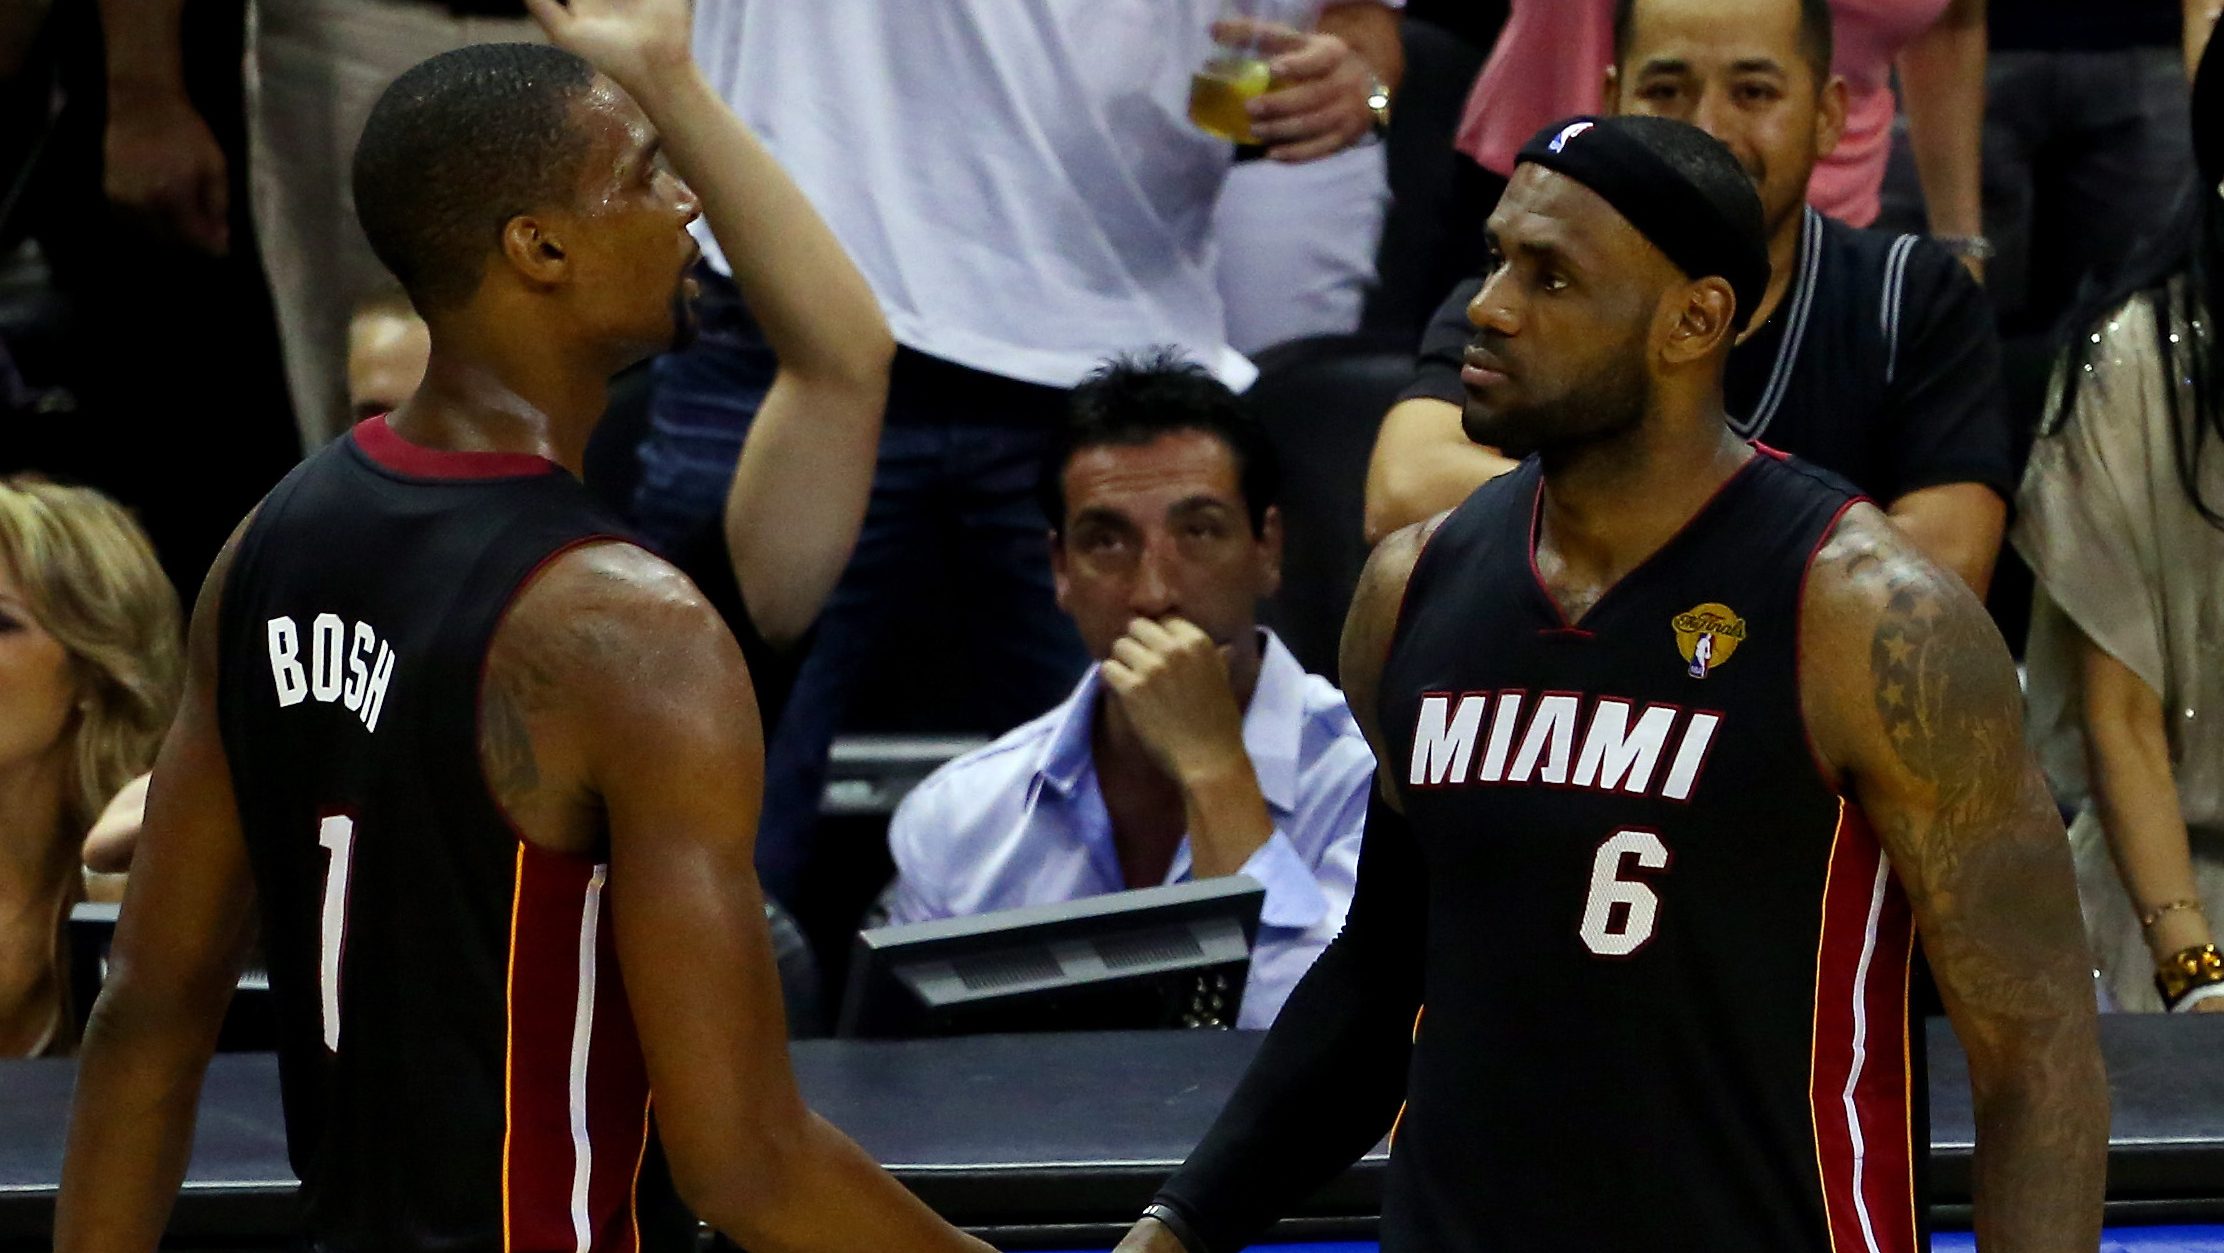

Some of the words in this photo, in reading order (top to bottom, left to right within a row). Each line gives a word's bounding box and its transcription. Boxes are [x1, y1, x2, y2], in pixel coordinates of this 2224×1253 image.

[267, 612, 396, 733] BOSH
[1698, 612, 1744, 638] Finals
[1409, 692, 1720, 801] MIAMI
[319, 814, 353, 1052] 1
[1579, 830, 1669, 956] 6
